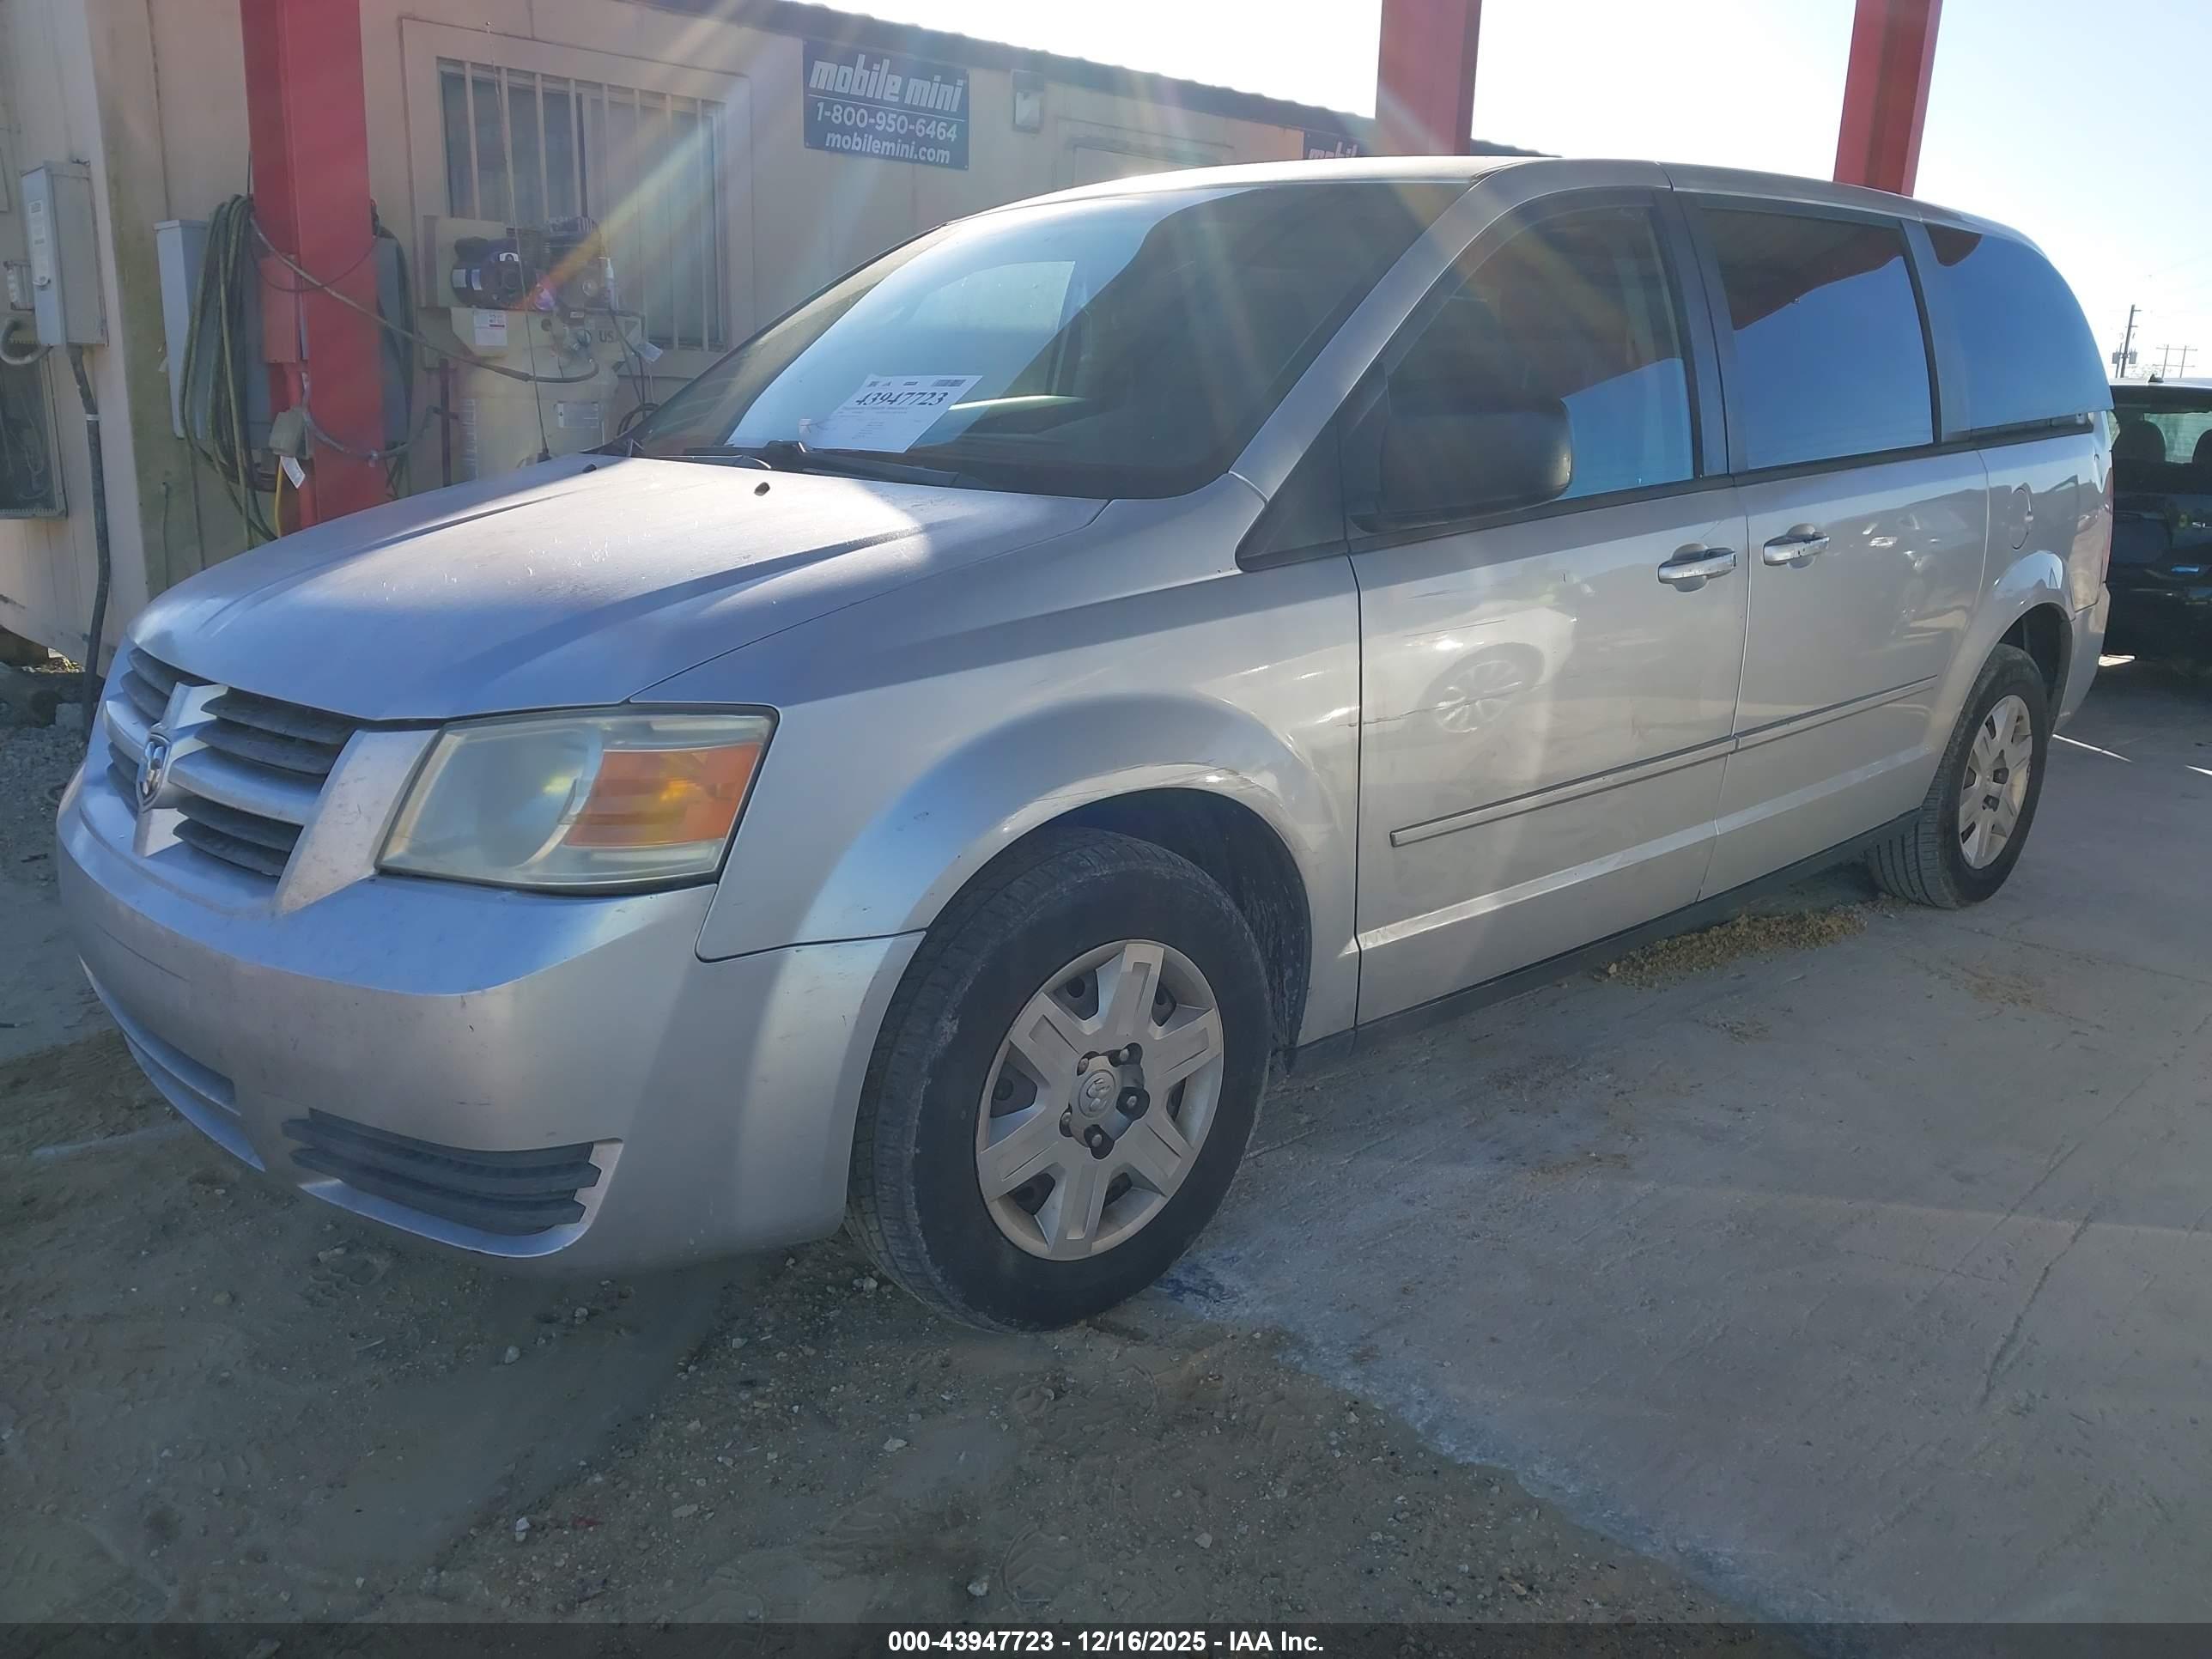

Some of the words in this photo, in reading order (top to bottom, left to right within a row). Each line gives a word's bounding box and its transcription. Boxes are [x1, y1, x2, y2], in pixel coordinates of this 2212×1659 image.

[809, 53, 902, 102] mobile
[904, 75, 963, 112] mini
[817, 101, 957, 142] 1-800-950-6464
[825, 131, 950, 164] mobilemini.com
[856, 392, 948, 405] 43947723
